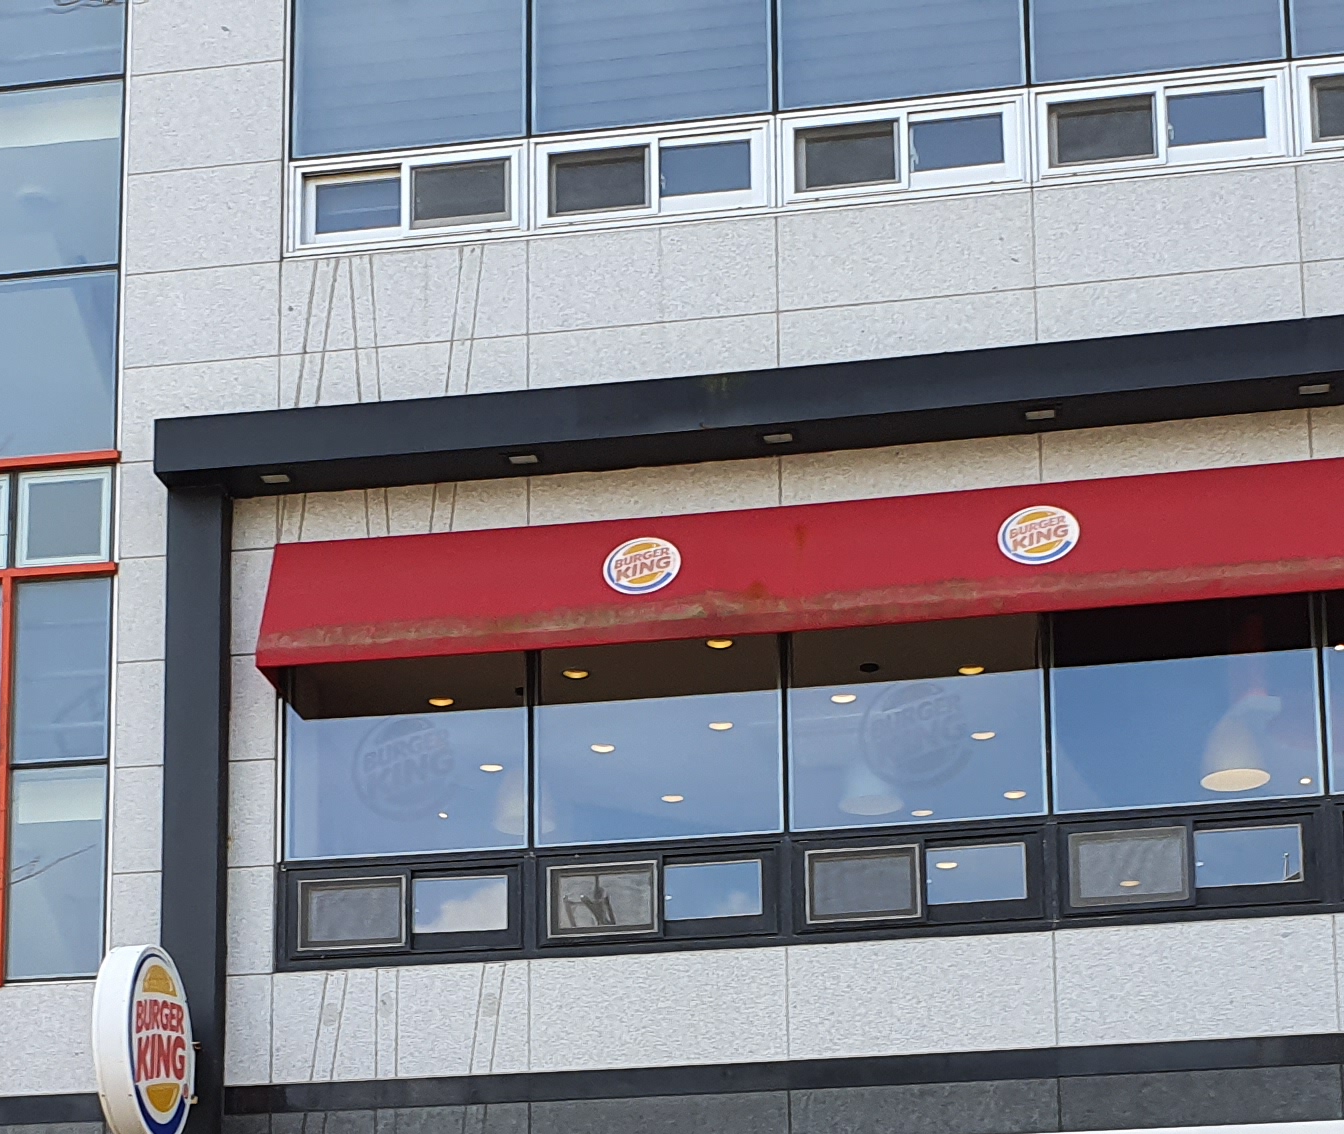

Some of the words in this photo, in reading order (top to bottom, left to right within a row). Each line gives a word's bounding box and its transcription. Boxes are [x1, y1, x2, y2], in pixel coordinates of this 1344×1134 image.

[1010, 516, 1066, 539] BURGER
[1012, 524, 1069, 552] KING
[614, 547, 670, 570] BURGER
[616, 556, 671, 583] KING
[136, 999, 185, 1034] BURGER
[135, 1034, 186, 1083] KING
